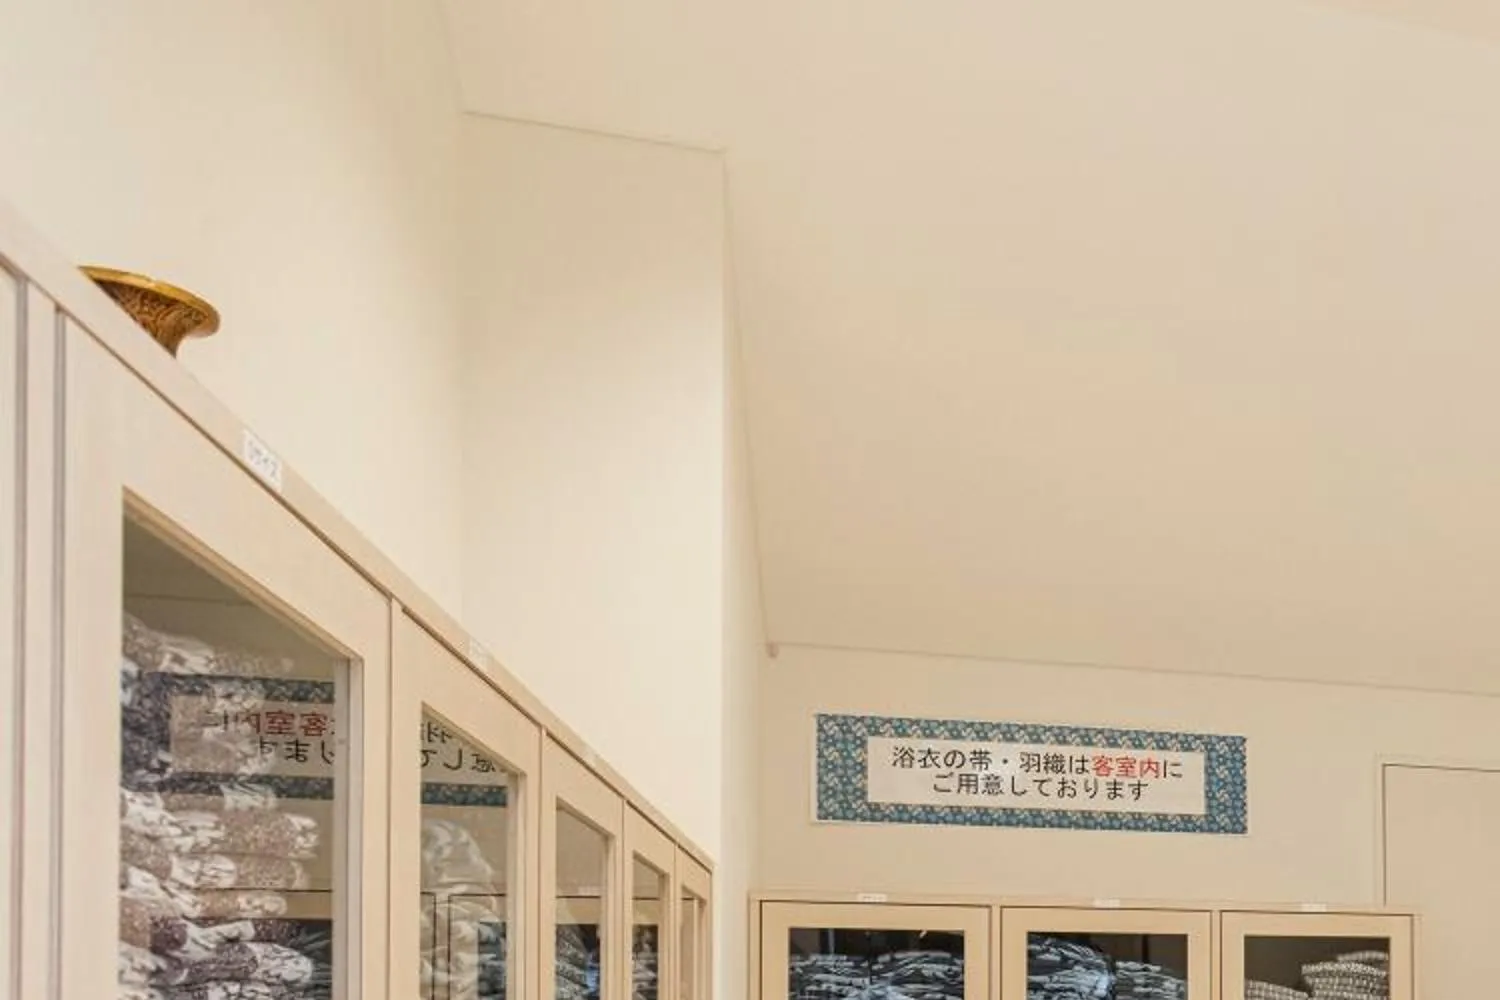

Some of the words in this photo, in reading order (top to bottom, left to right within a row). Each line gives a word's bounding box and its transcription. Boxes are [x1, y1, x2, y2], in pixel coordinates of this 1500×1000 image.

[892, 746, 1184, 779] 浴衣の帯・羽織は客室内に
[932, 772, 1149, 801] ご用意しております
